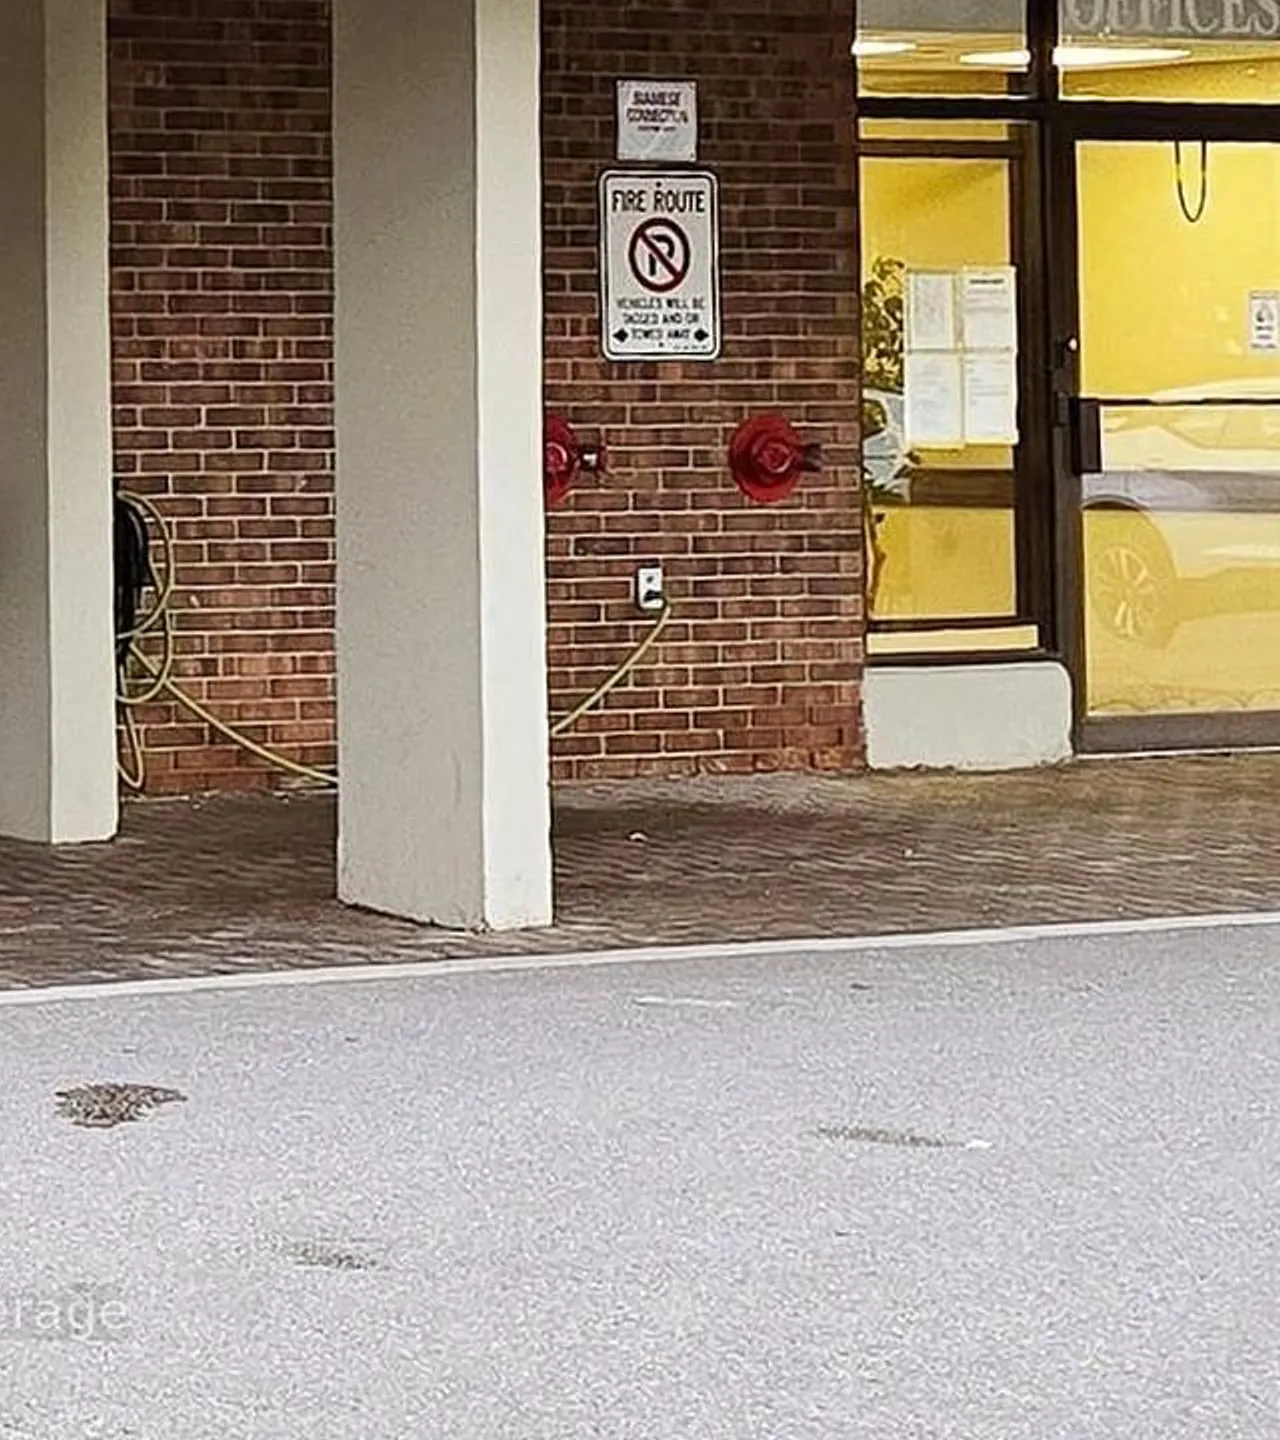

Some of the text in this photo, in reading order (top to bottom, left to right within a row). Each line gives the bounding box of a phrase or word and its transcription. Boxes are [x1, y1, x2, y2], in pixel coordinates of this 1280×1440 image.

[611, 190, 705, 212] FIRE ROUTE
[662, 312, 682, 324] AND
